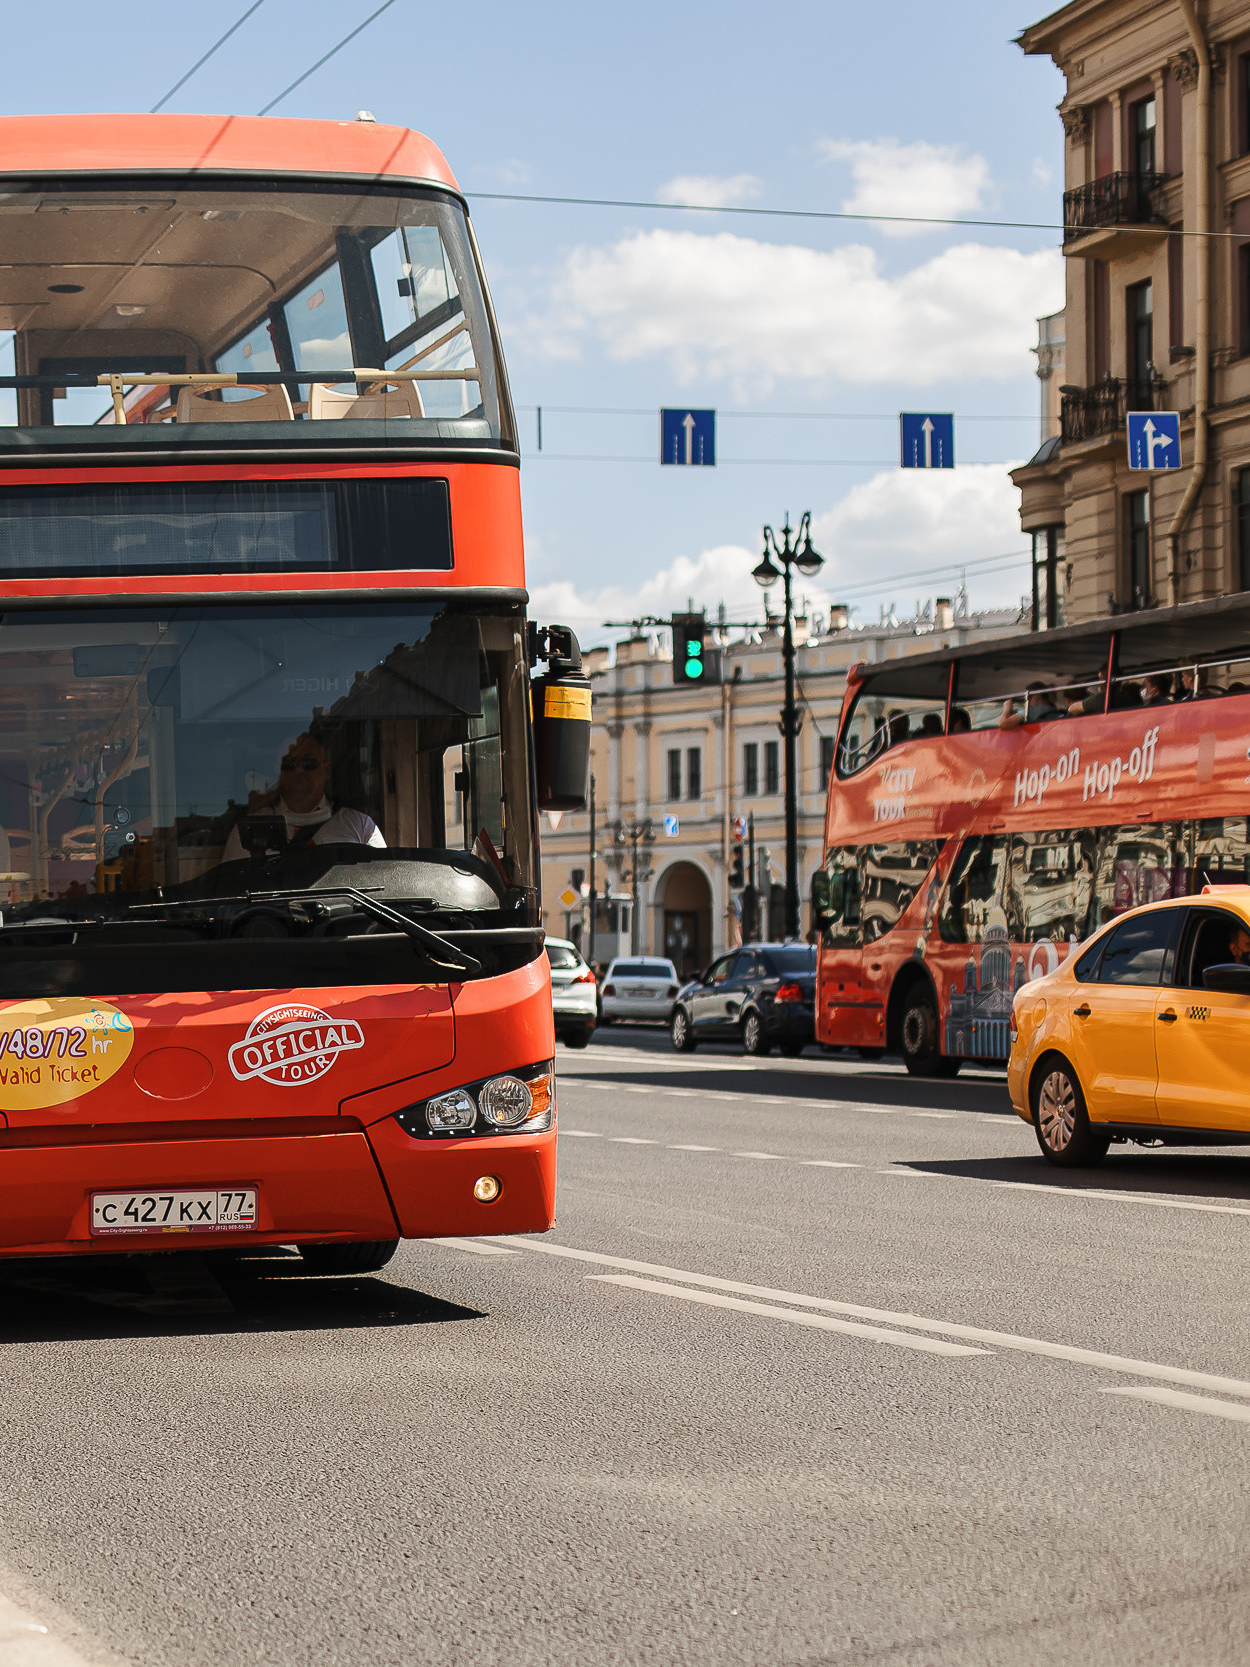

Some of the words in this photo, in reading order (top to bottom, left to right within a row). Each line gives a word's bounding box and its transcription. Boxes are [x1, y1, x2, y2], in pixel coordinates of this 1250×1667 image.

[1014, 747, 1080, 807] Hop-on
[1082, 725, 1160, 803] Hop-off
[887, 767, 917, 793] CITY
[874, 795, 905, 822] TOUR
[256, 1008, 324, 1035] CITYSIGHTSEEING
[91, 1035, 113, 1054] hr
[243, 1025, 356, 1069] OFFICIAL
[0, 1066, 41, 1085] Valid
[49, 1064, 101, 1083] Ticket
[281, 1055, 330, 1079] TOUR
[220, 1192, 247, 1213] 77
[219, 1212, 240, 1221] RUS
